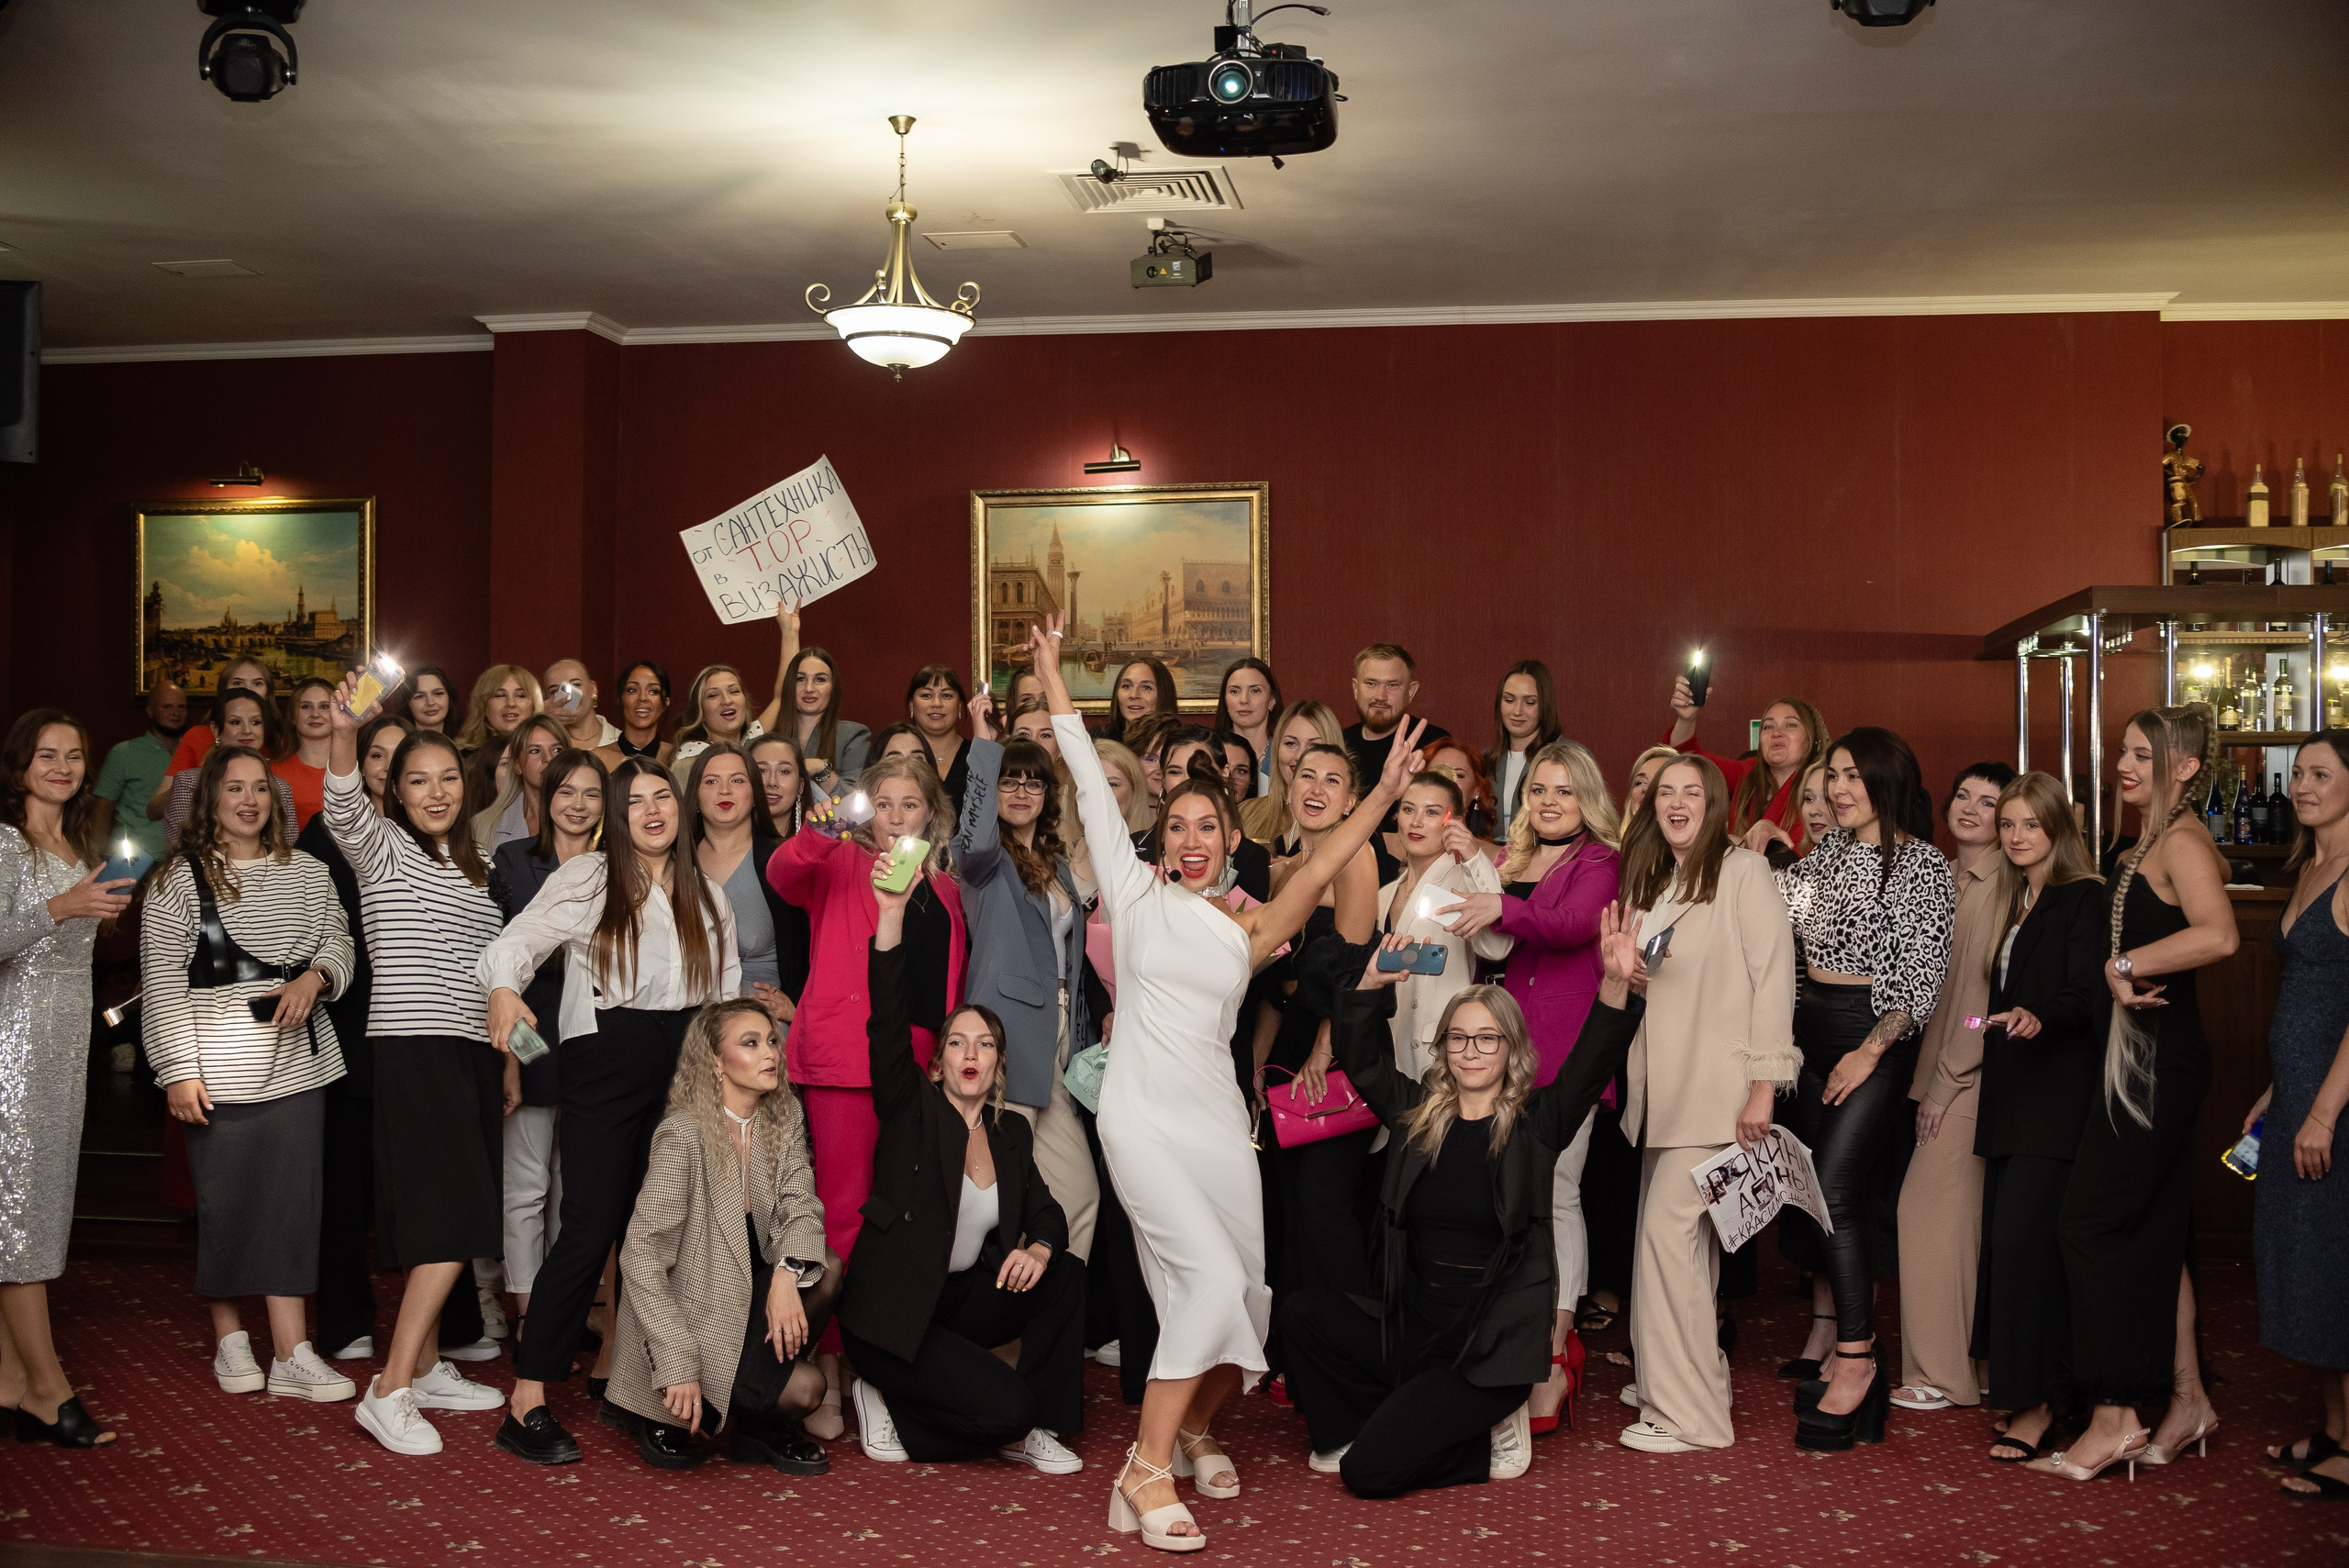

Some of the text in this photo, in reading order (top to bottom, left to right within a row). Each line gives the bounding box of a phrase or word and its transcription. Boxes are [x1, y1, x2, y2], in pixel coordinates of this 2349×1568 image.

[713, 465, 841, 556] САНТЕХНИКА
[718, 526, 874, 619] ВИЗАЖИСТЫ
[968, 773, 988, 828] MYSELF
